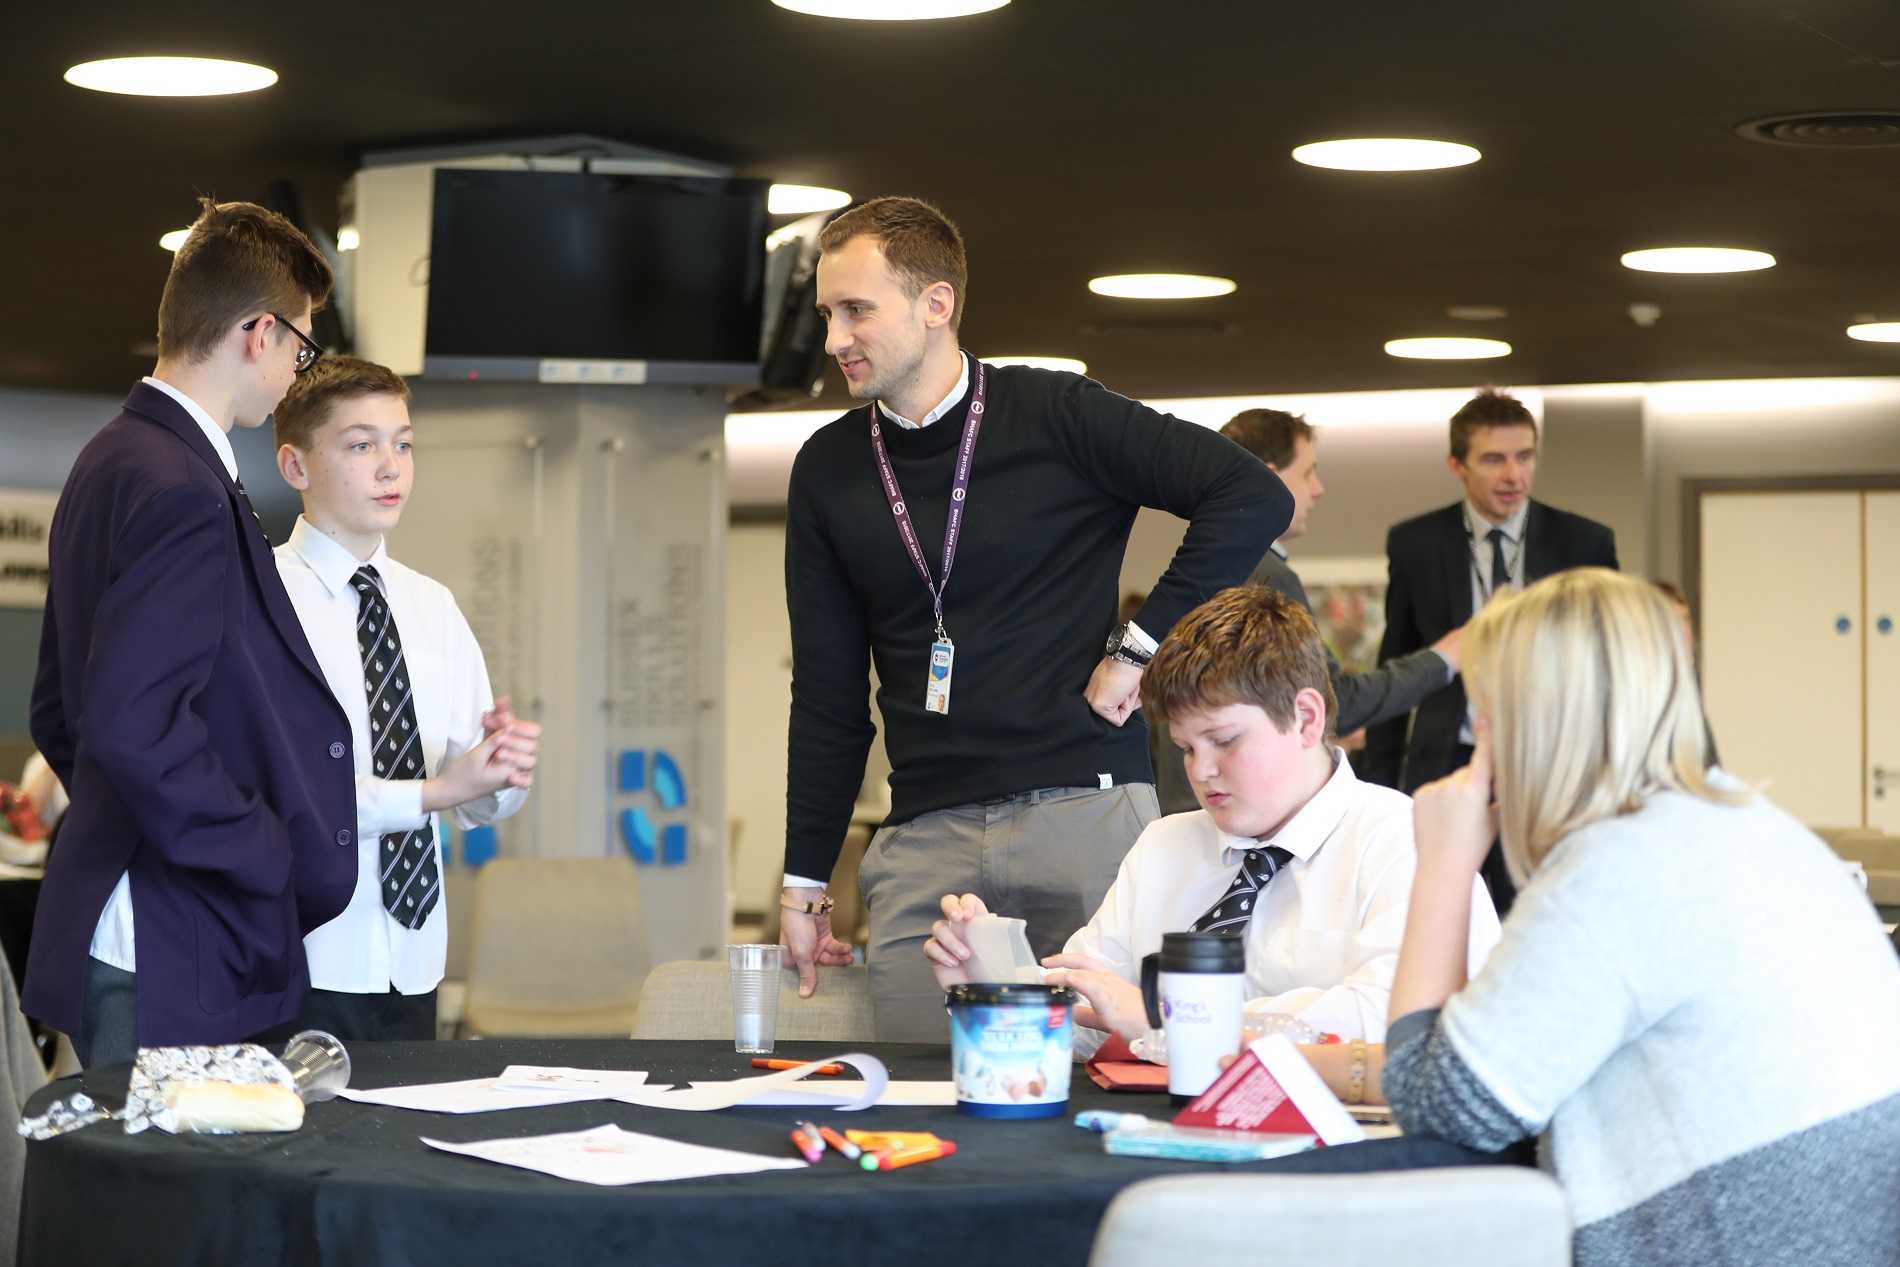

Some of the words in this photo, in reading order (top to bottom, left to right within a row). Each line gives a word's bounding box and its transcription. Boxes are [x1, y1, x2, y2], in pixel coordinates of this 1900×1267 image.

[967, 419, 977, 438] BHAFC
[964, 438, 972, 455] STAFF
[882, 464, 891, 480] STAFF
[958, 455, 969, 481] 2017/2018
[951, 508, 959, 528] BHAFC
[948, 528, 956, 546] STAFF
[910, 544, 920, 560] STAFF
[1174, 997, 1207, 1014] King's
[1174, 1012, 1213, 1024] School
